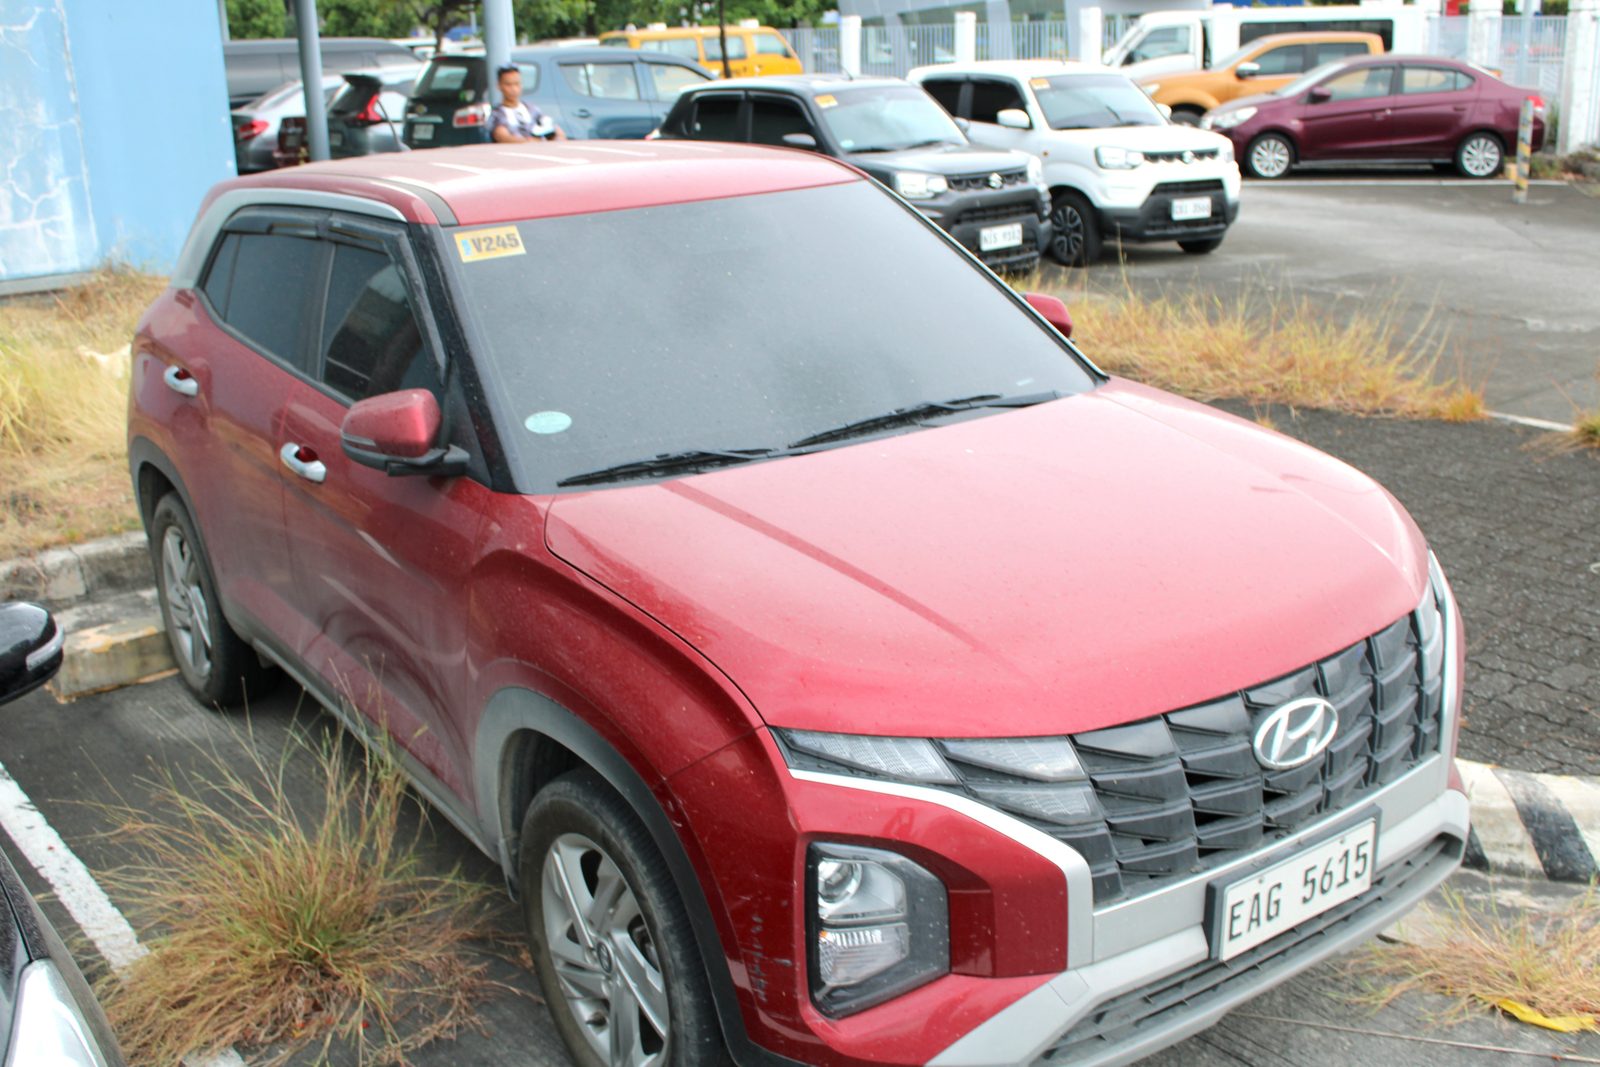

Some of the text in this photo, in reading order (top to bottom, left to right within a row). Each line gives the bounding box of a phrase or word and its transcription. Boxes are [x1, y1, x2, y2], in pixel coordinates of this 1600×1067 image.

[472, 232, 520, 253] V245
[1229, 840, 1369, 941] EAG 5615
